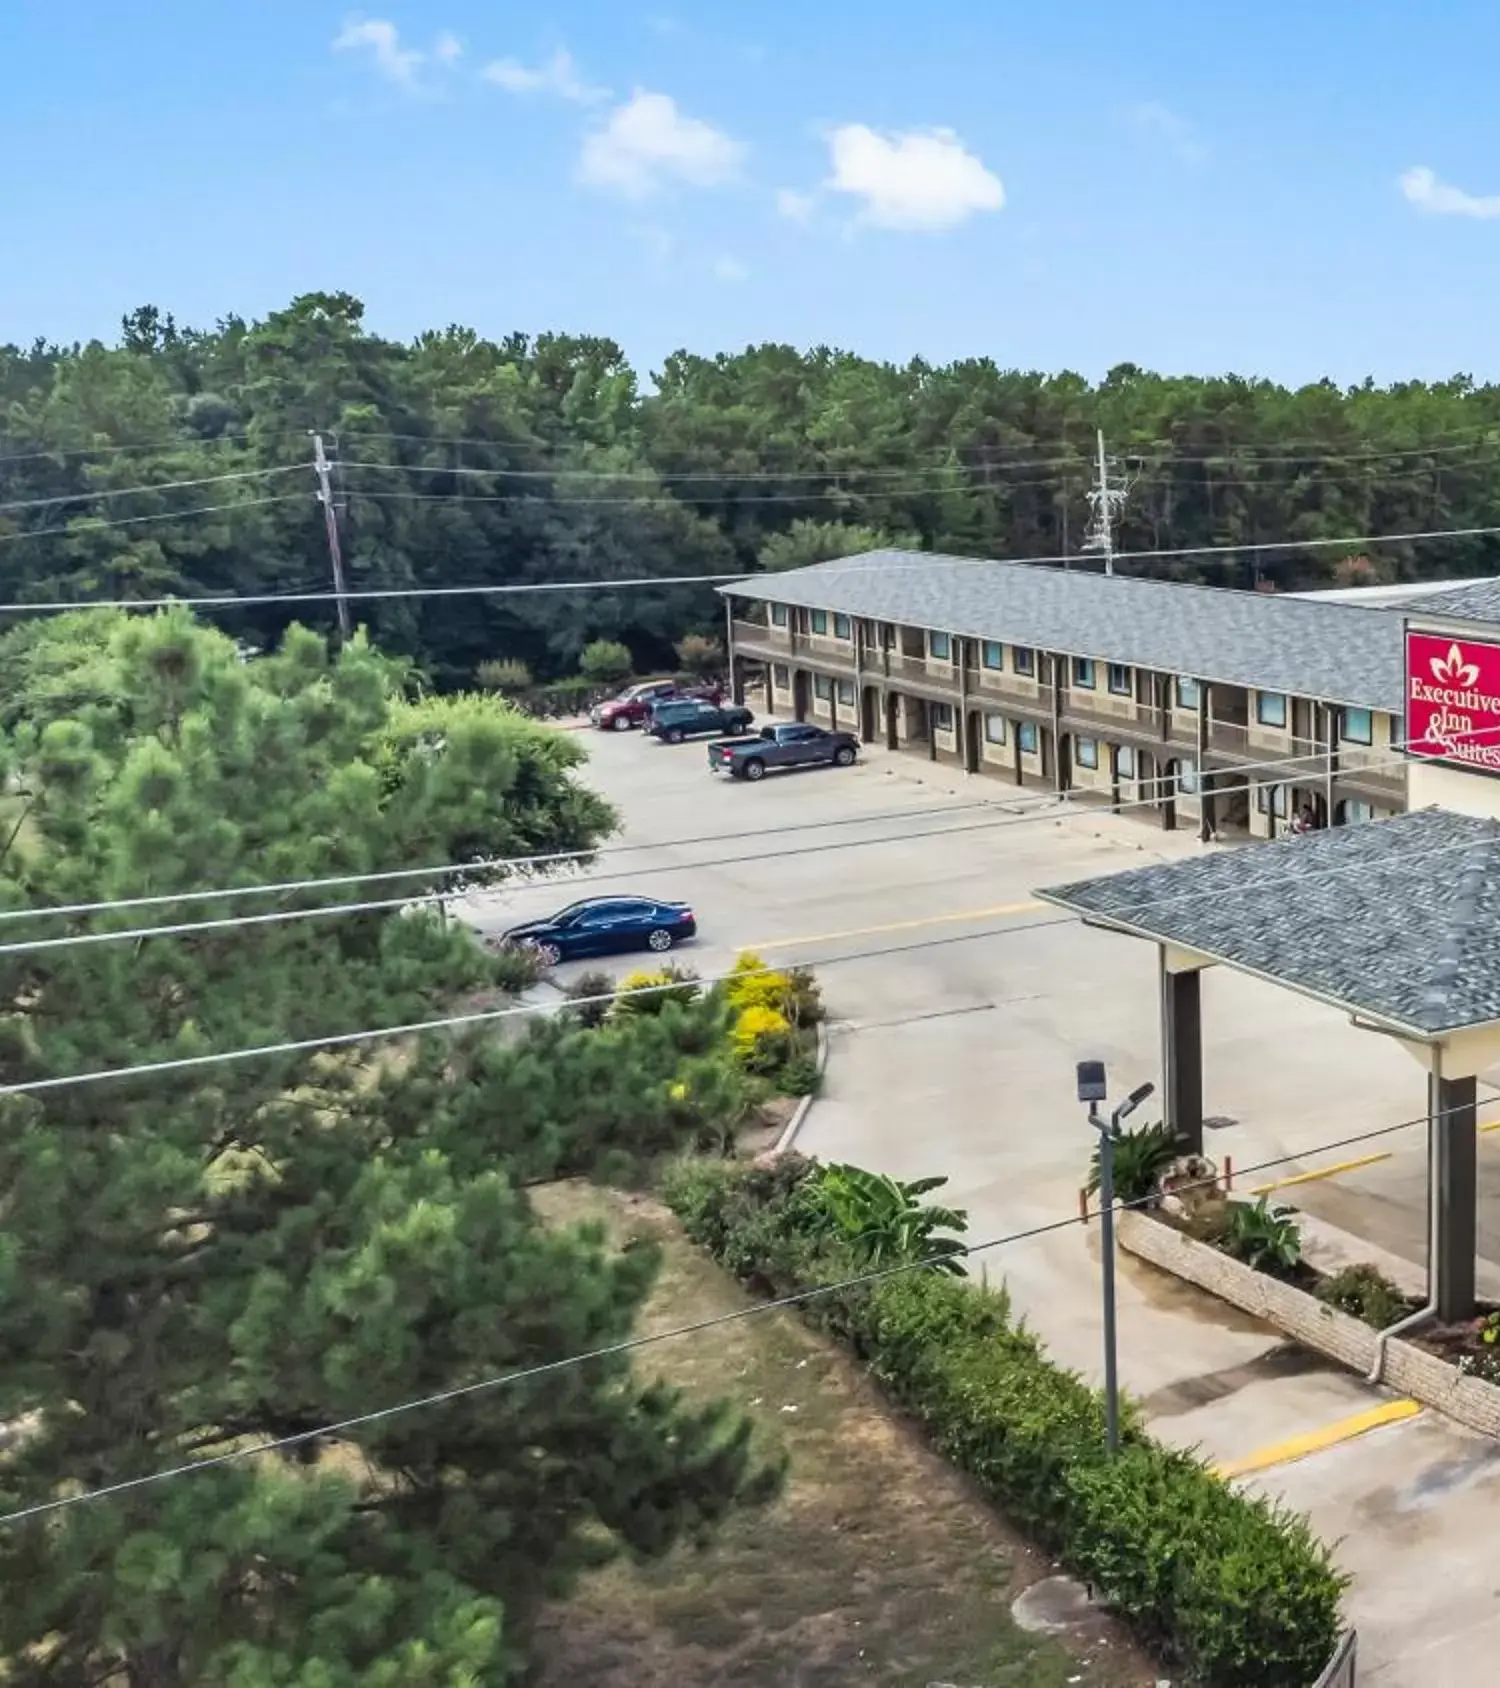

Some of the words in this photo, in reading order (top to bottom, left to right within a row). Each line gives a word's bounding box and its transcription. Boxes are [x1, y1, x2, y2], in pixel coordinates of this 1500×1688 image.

[1424, 712, 1451, 745] &
[1446, 736, 1500, 766] Suites
[1441, 705, 1473, 734] Inn
